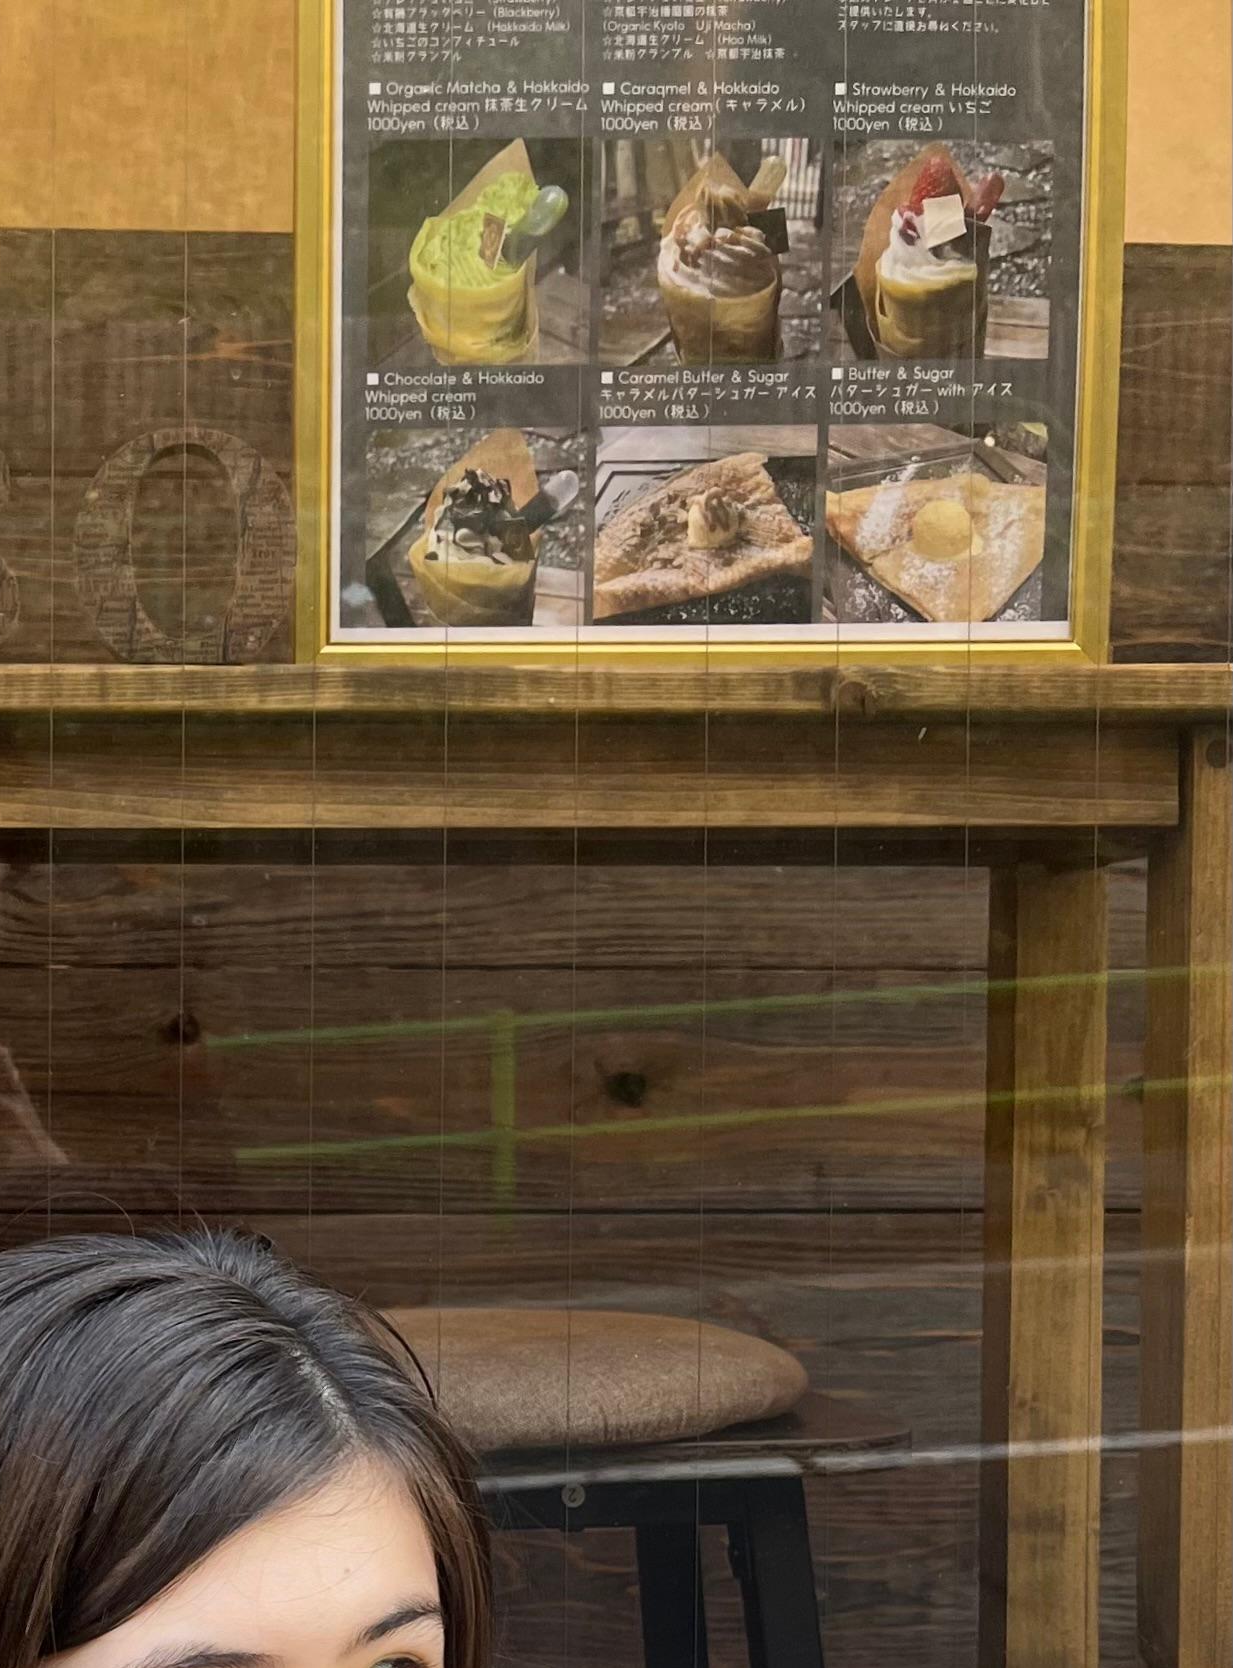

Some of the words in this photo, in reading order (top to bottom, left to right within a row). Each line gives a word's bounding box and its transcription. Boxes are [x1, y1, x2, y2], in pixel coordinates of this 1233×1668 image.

[386, 82, 442, 98] Orgaic
[446, 81, 501, 94] Matcha
[507, 82, 517, 94] &
[524, 80, 590, 94] Hokkaido
[697, 82, 707, 95] &
[714, 82, 779, 95] Hokkaido
[853, 83, 928, 99] Strawberry
[935, 83, 945, 96] &
[951, 83, 1016, 96] Hokkaido
[367, 101, 430, 116] Whipped
[435, 102, 480, 113] cream
[485, 98, 587, 113] 抹茶生クリーム
[601, 100, 663, 117] Whipped
[833, 101, 895, 116] Whipped
[900, 103, 943, 114] cream
[949, 100, 992, 114] いちご
[367, 118, 425, 133] 1000yen
[601, 117, 658, 133] 1000yen
[833, 117, 889, 133] 1000yen
[384, 372, 457, 386] Chocolate
[462, 372, 472, 385] &
[478, 371, 544, 385] Hokkaido
[618, 371, 679, 385] Caramel
[683, 370, 724, 384] Butter
[731, 370, 741, 384] &
[748, 369, 789, 386] Sugar
[848, 367, 890, 380] Butter
[897, 367, 907, 380] &
[914, 366, 954, 383] Sugar
[365, 390, 427, 405] Whipped
[432, 391, 476, 402] cream
[937, 383, 965, 397] with
[972, 382, 1013, 396] アイス
[365, 407, 422, 423] 1000yen
[599, 405, 656, 422] 1000yen
[829, 402, 886, 418] 1000yen
